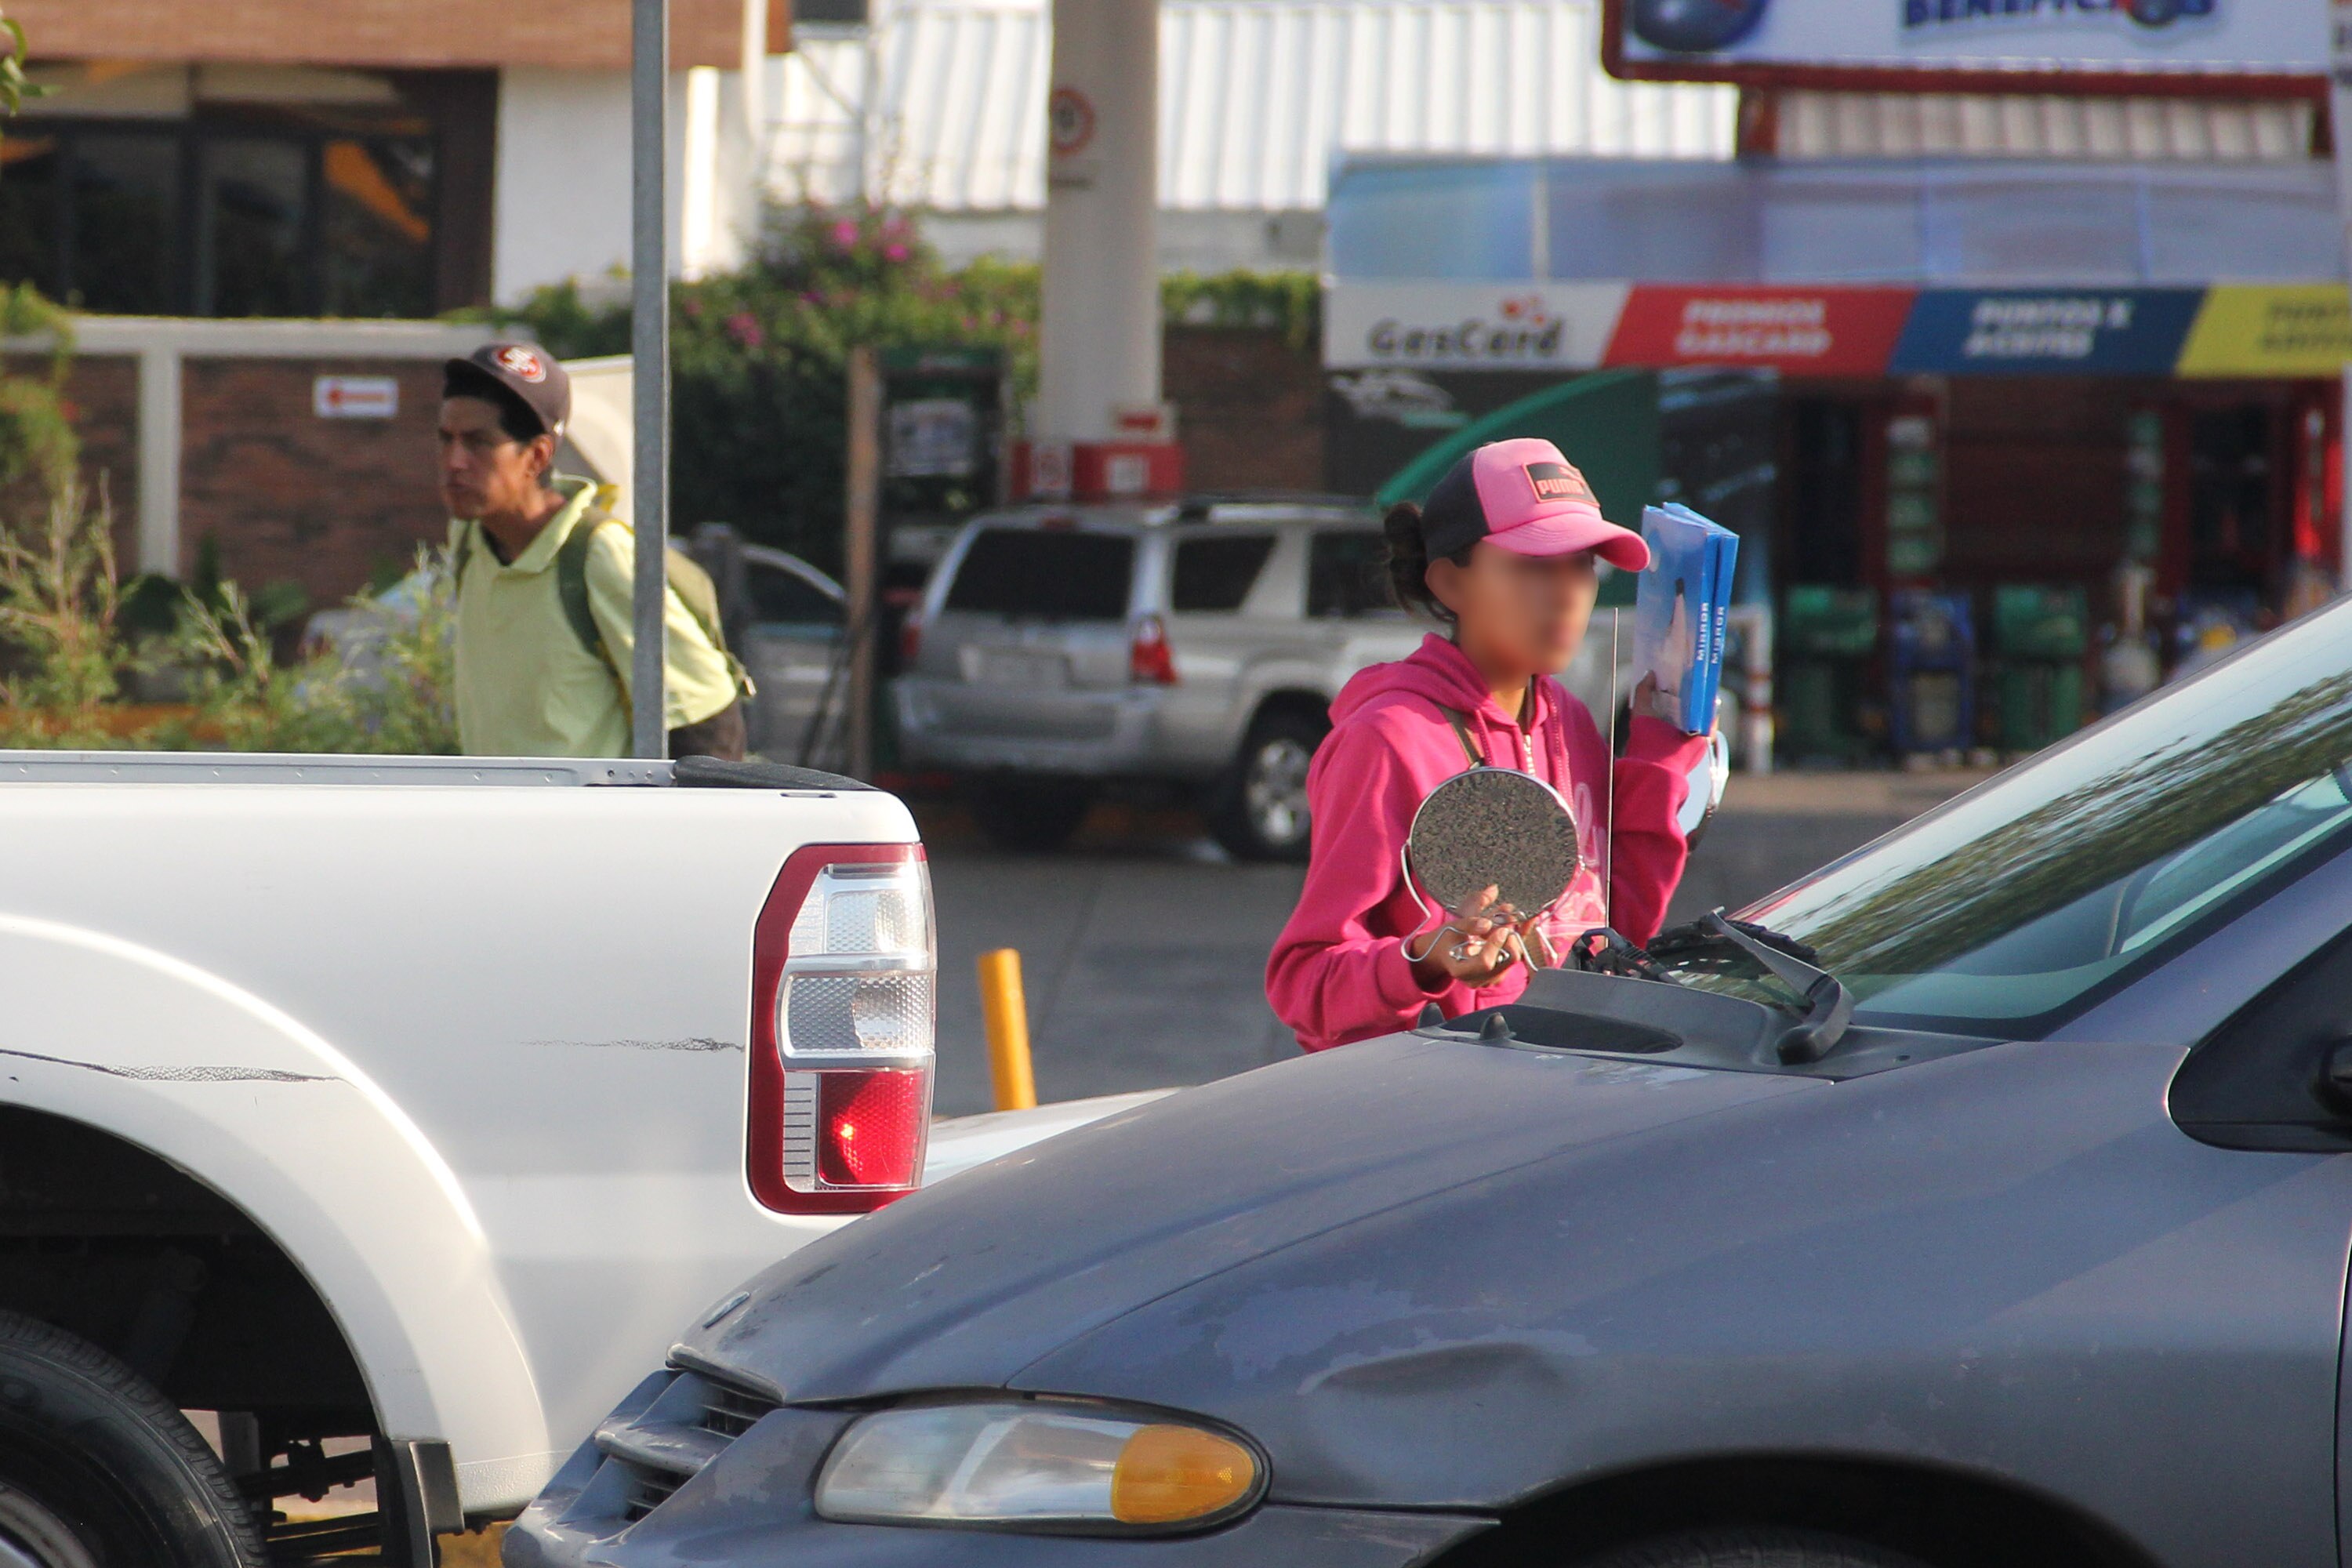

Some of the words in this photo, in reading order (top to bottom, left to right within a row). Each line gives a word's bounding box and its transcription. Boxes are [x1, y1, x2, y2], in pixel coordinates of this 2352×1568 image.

[1369, 318, 1563, 358] GasCard
[1535, 479, 1584, 495] PUMA
[1697, 602, 1709, 661] MIRROR
[1711, 606, 1725, 664] MIRROR
